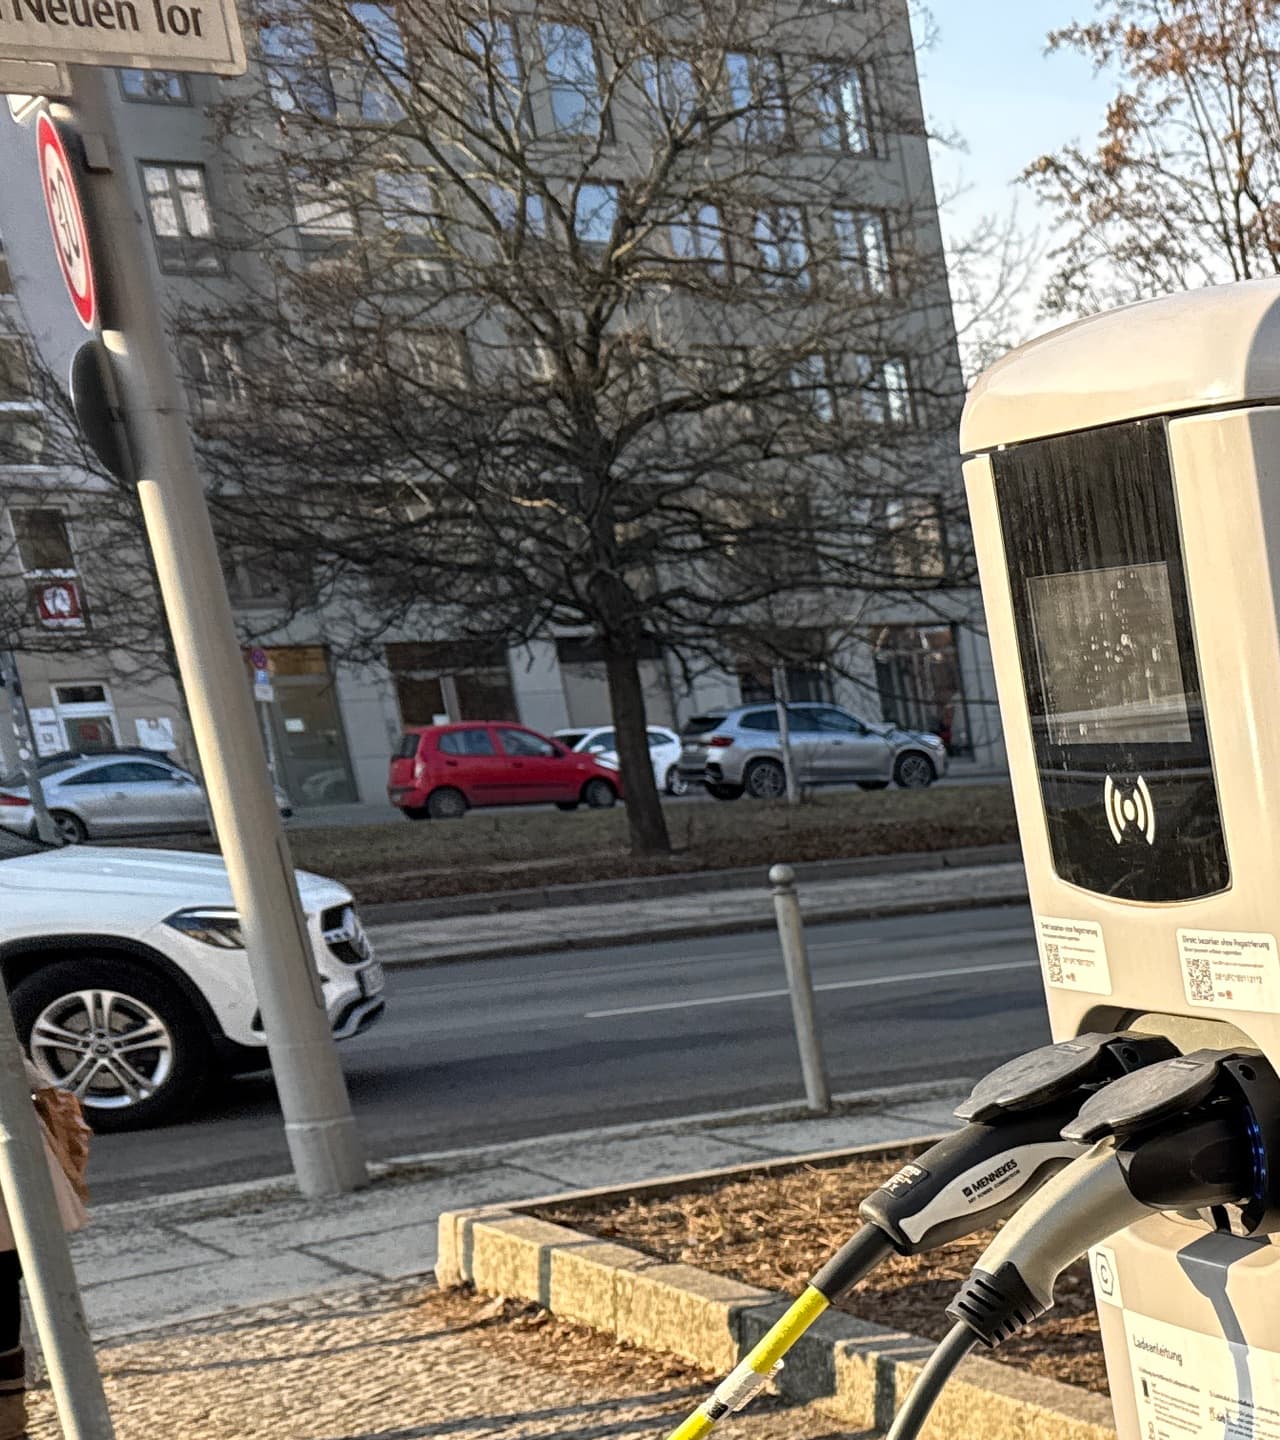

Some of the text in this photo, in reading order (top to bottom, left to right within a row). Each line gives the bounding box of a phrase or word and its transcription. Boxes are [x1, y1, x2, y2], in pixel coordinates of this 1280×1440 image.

[153, 0, 204, 37] Tor
[50, 168, 80, 267] 30
[972, 1158, 1018, 1193] MENNEKES
